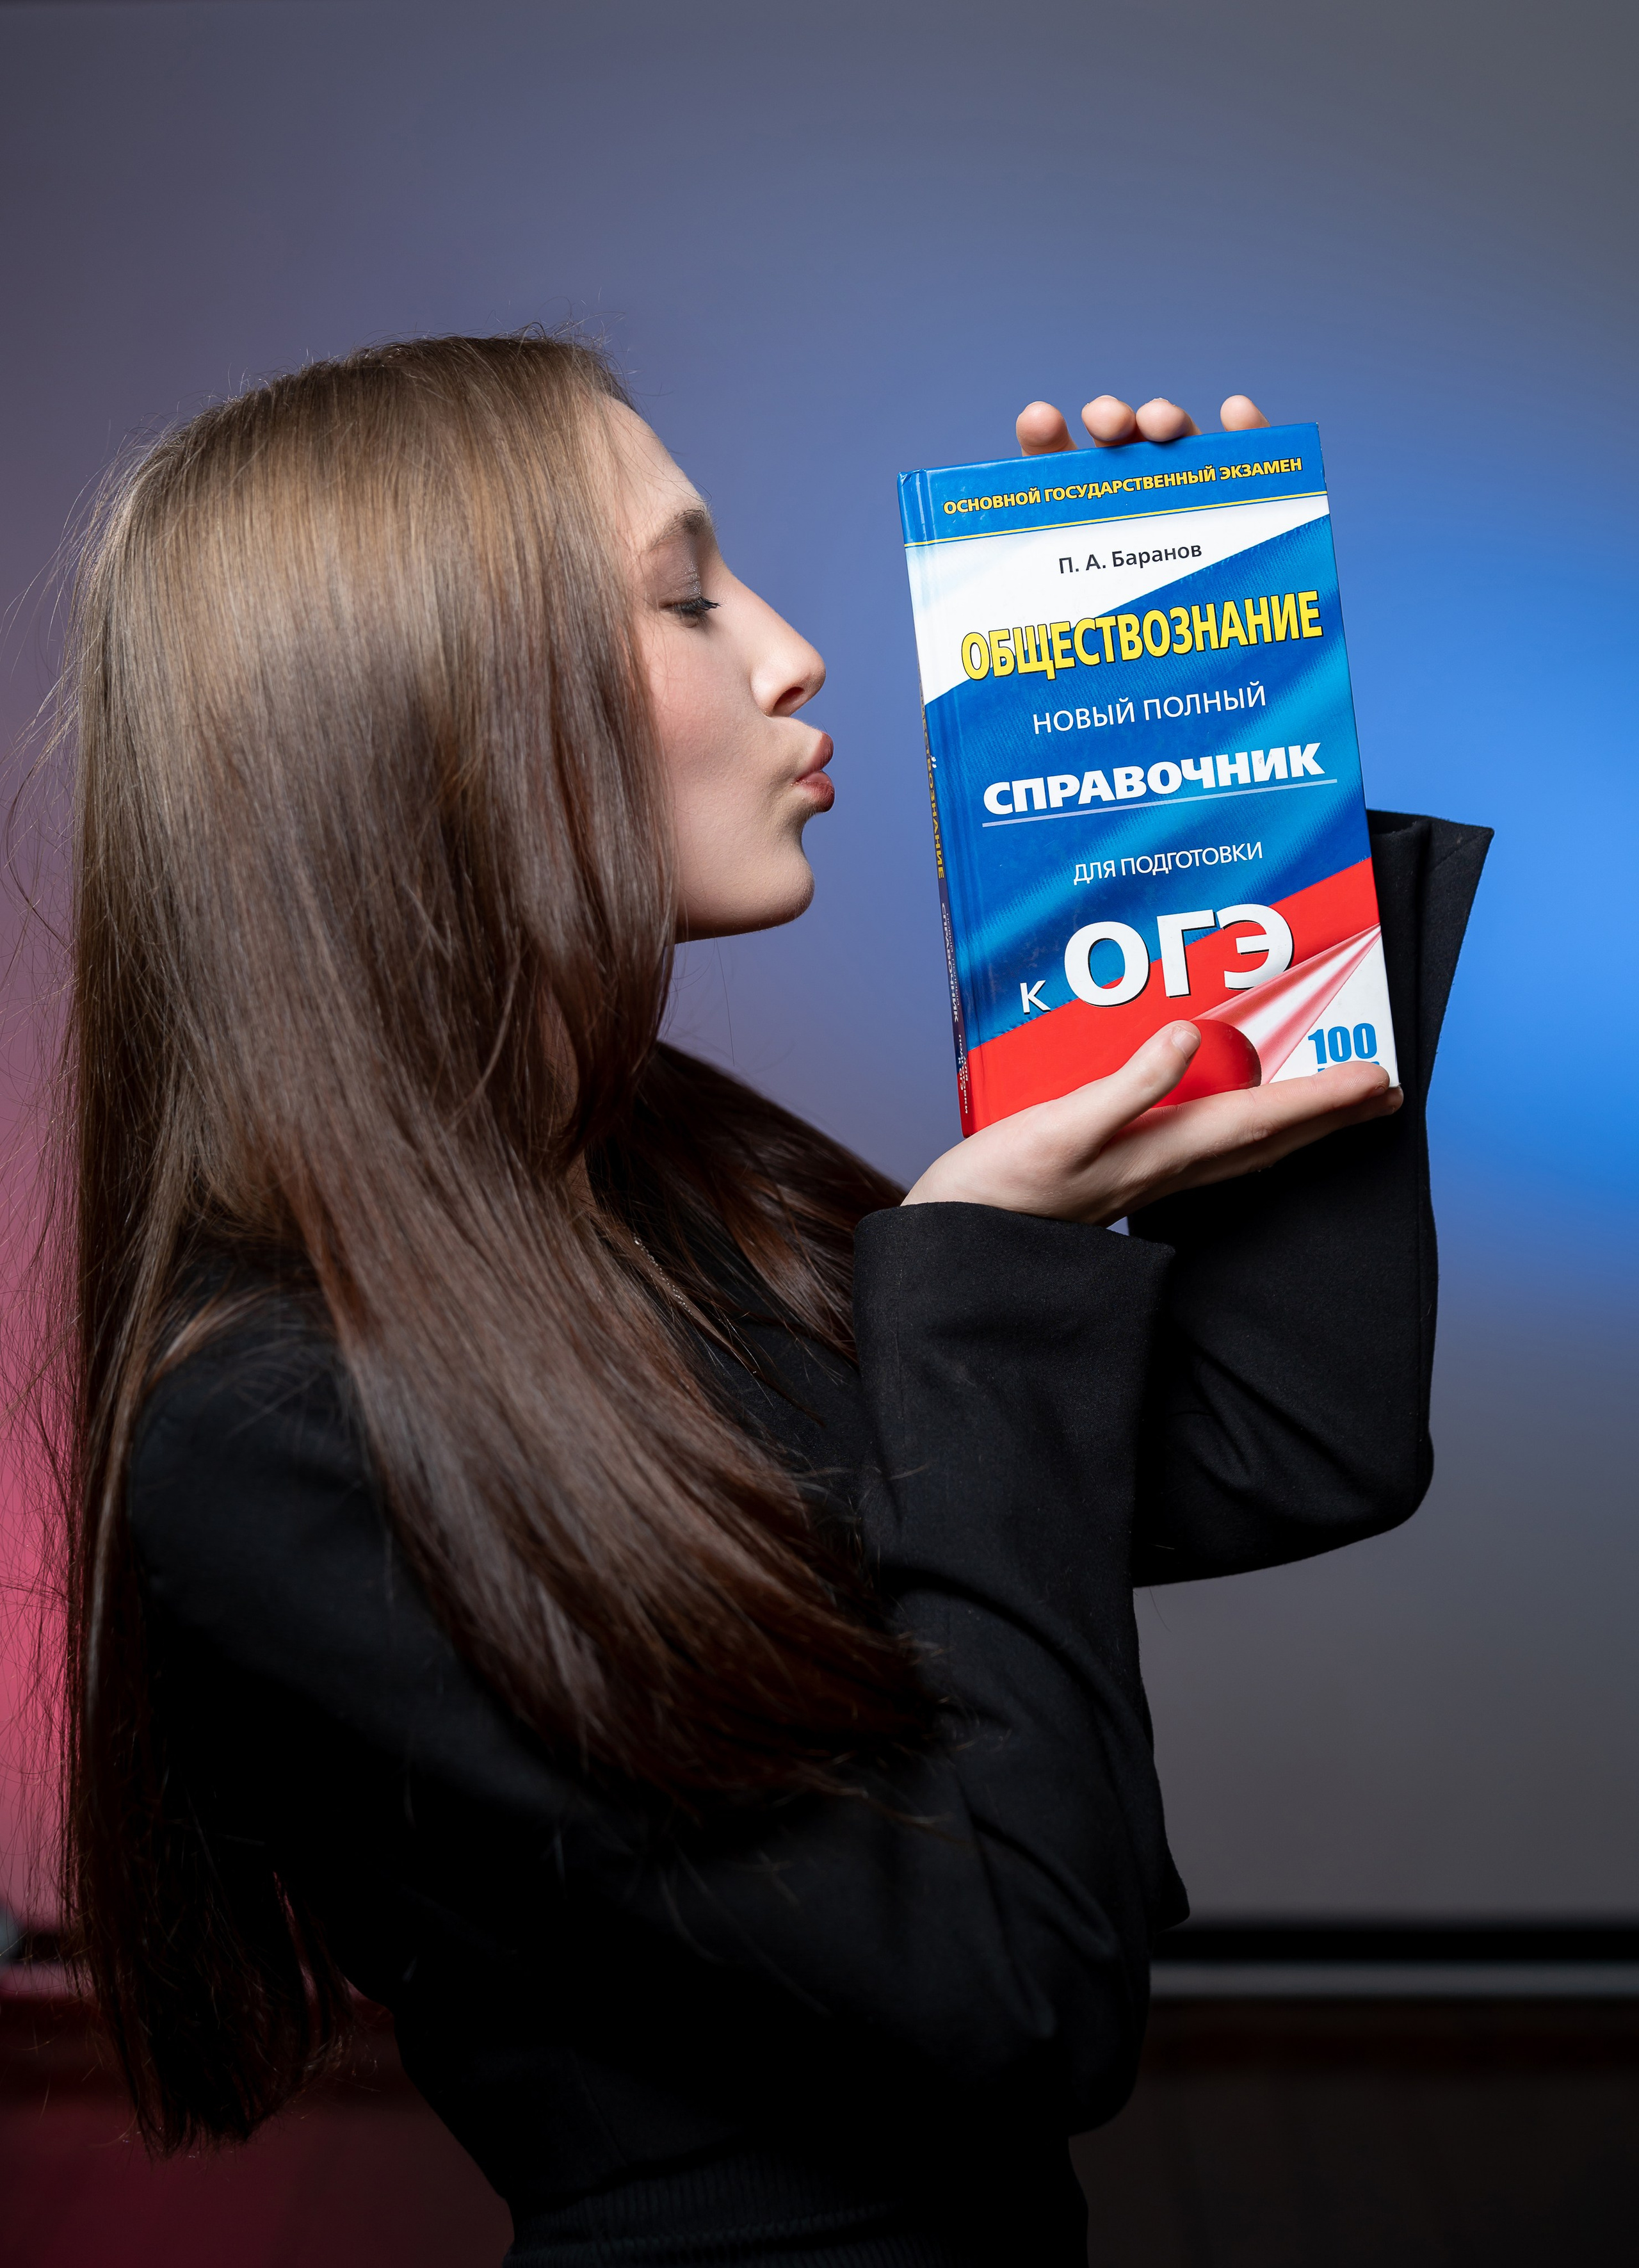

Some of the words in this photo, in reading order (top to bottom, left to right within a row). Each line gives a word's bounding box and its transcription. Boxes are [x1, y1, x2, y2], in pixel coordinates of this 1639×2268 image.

[943, 487, 1041, 515] ОСНОВНОЙ
[1044, 465, 1216, 499] ГОСУДАРСТВЕННЫЙ
[1219, 457, 1302, 480] ЭКЗАМЕН
[1059, 557, 1079, 574] П.
[1085, 554, 1106, 571] А.
[1111, 544, 1202, 569] Баранов
[961, 590, 1323, 681] ОБЩЕСТВОЗНАНИЕ
[1033, 697, 1136, 734] НОВЫЙ
[1143, 681, 1267, 721] ПОЛНЫЙ
[983, 742, 1325, 815] СПРАВОЧНИК
[1073, 859, 1117, 885] ДЛЯ
[1121, 841, 1263, 877] ПОДГОТОВКИ
[941, 902, 959, 1023] СПРАВОЧНИК
[1064, 903, 1295, 1008] ОГЭ
[1308, 1023, 1377, 1064] 100
